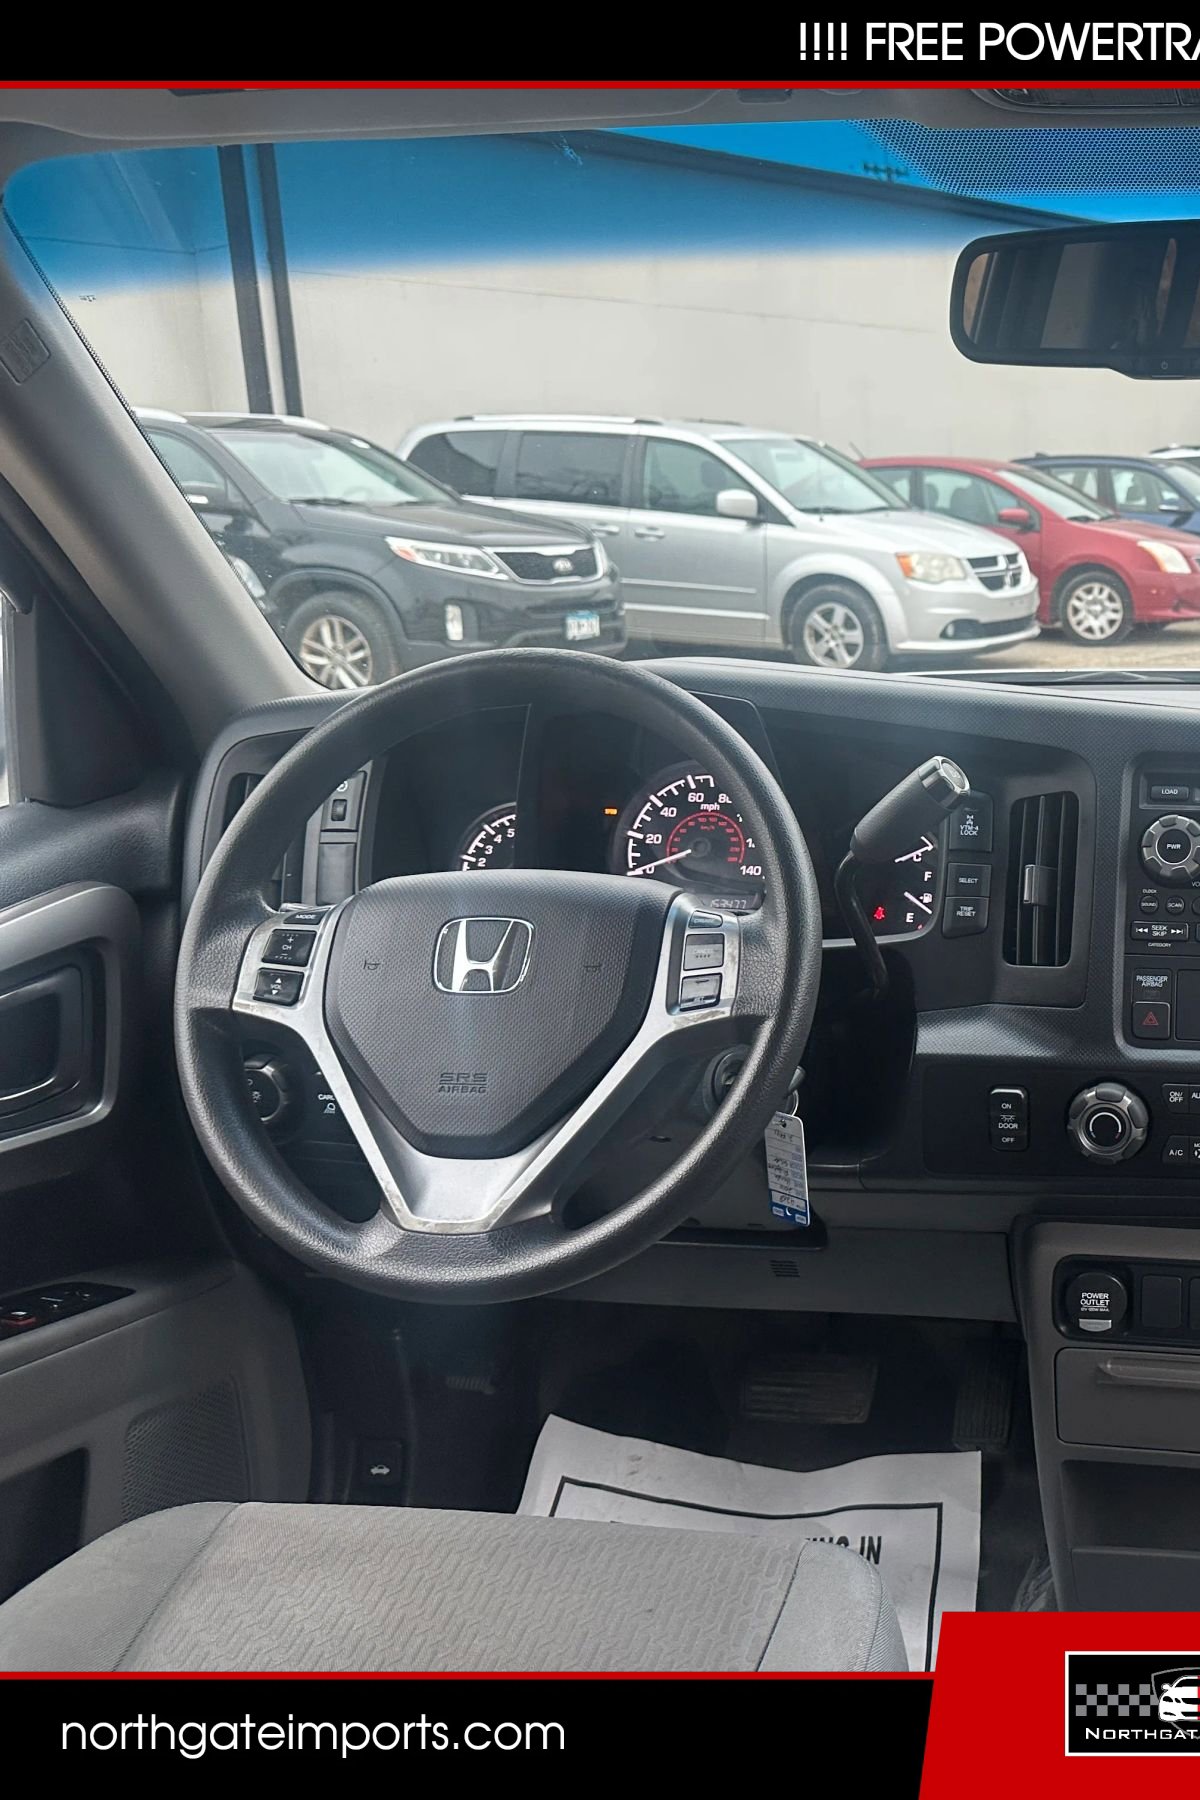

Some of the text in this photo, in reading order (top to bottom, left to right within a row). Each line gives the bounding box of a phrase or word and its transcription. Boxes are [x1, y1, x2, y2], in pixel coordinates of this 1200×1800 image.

[1161, 788, 1179, 796] LOAD
[687, 792, 705, 803] 60
[700, 803, 720, 812] mph
[660, 807, 677, 818] 40
[506, 828, 515, 838] 5
[493, 834, 503, 844] 4
[645, 833, 663, 845] 20
[484, 845, 494, 855] 3
[477, 857, 487, 867] 2
[739, 865, 762, 876] 140
[924, 872, 932, 881] F
[906, 913, 914, 922] E
[1136, 975, 1169, 983] PASSENGER
[269, 983, 282, 991] VOL
[439, 1072, 488, 1083] SRS
[438, 1085, 488, 1094] AIRBAG
[1001, 1102, 1012, 1110] ON
[1081, 1292, 1110, 1300] POWER
[1080, 1298, 1110, 1306] OUTLET
[859, 1535, 882, 1565] IN
